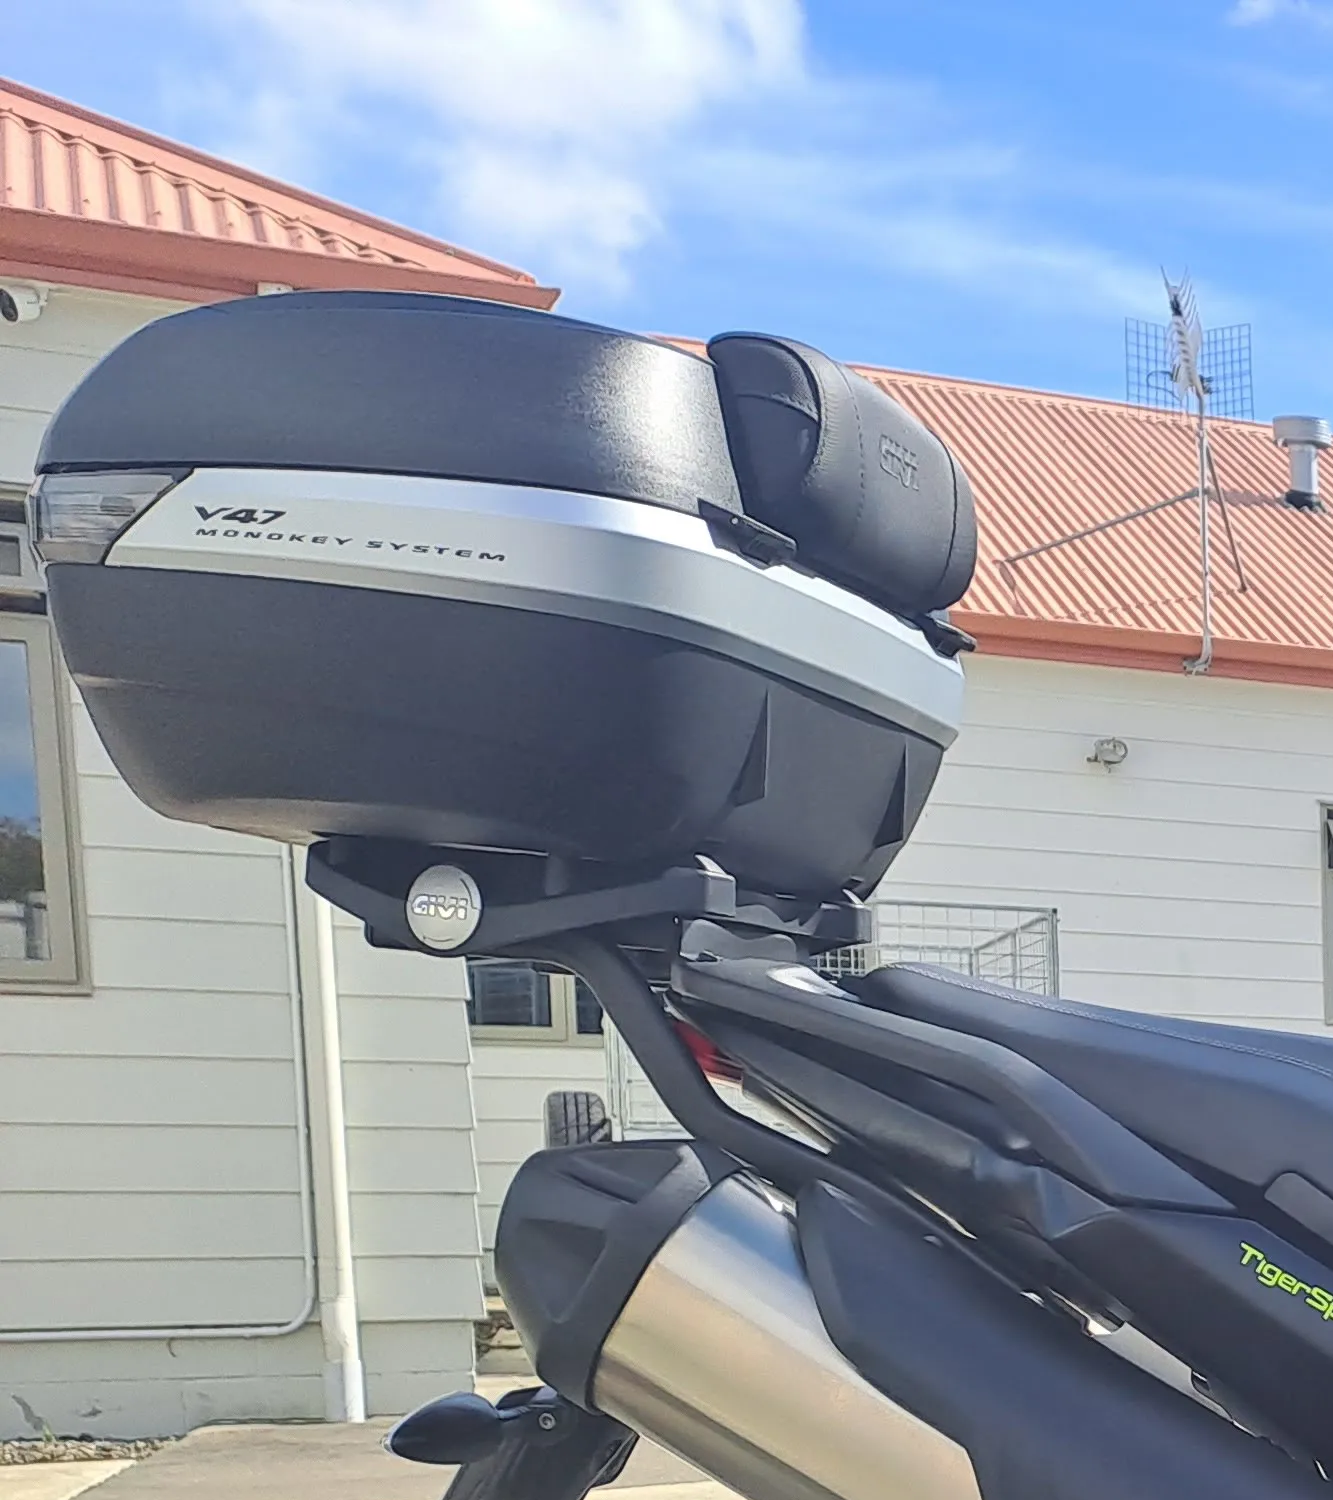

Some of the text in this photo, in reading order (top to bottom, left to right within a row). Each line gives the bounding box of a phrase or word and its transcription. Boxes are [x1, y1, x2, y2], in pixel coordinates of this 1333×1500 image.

[194, 505, 288, 525] V47
[194, 528, 507, 562] MONOKEY SYSTEM
[411, 894, 469, 920] GIVI
